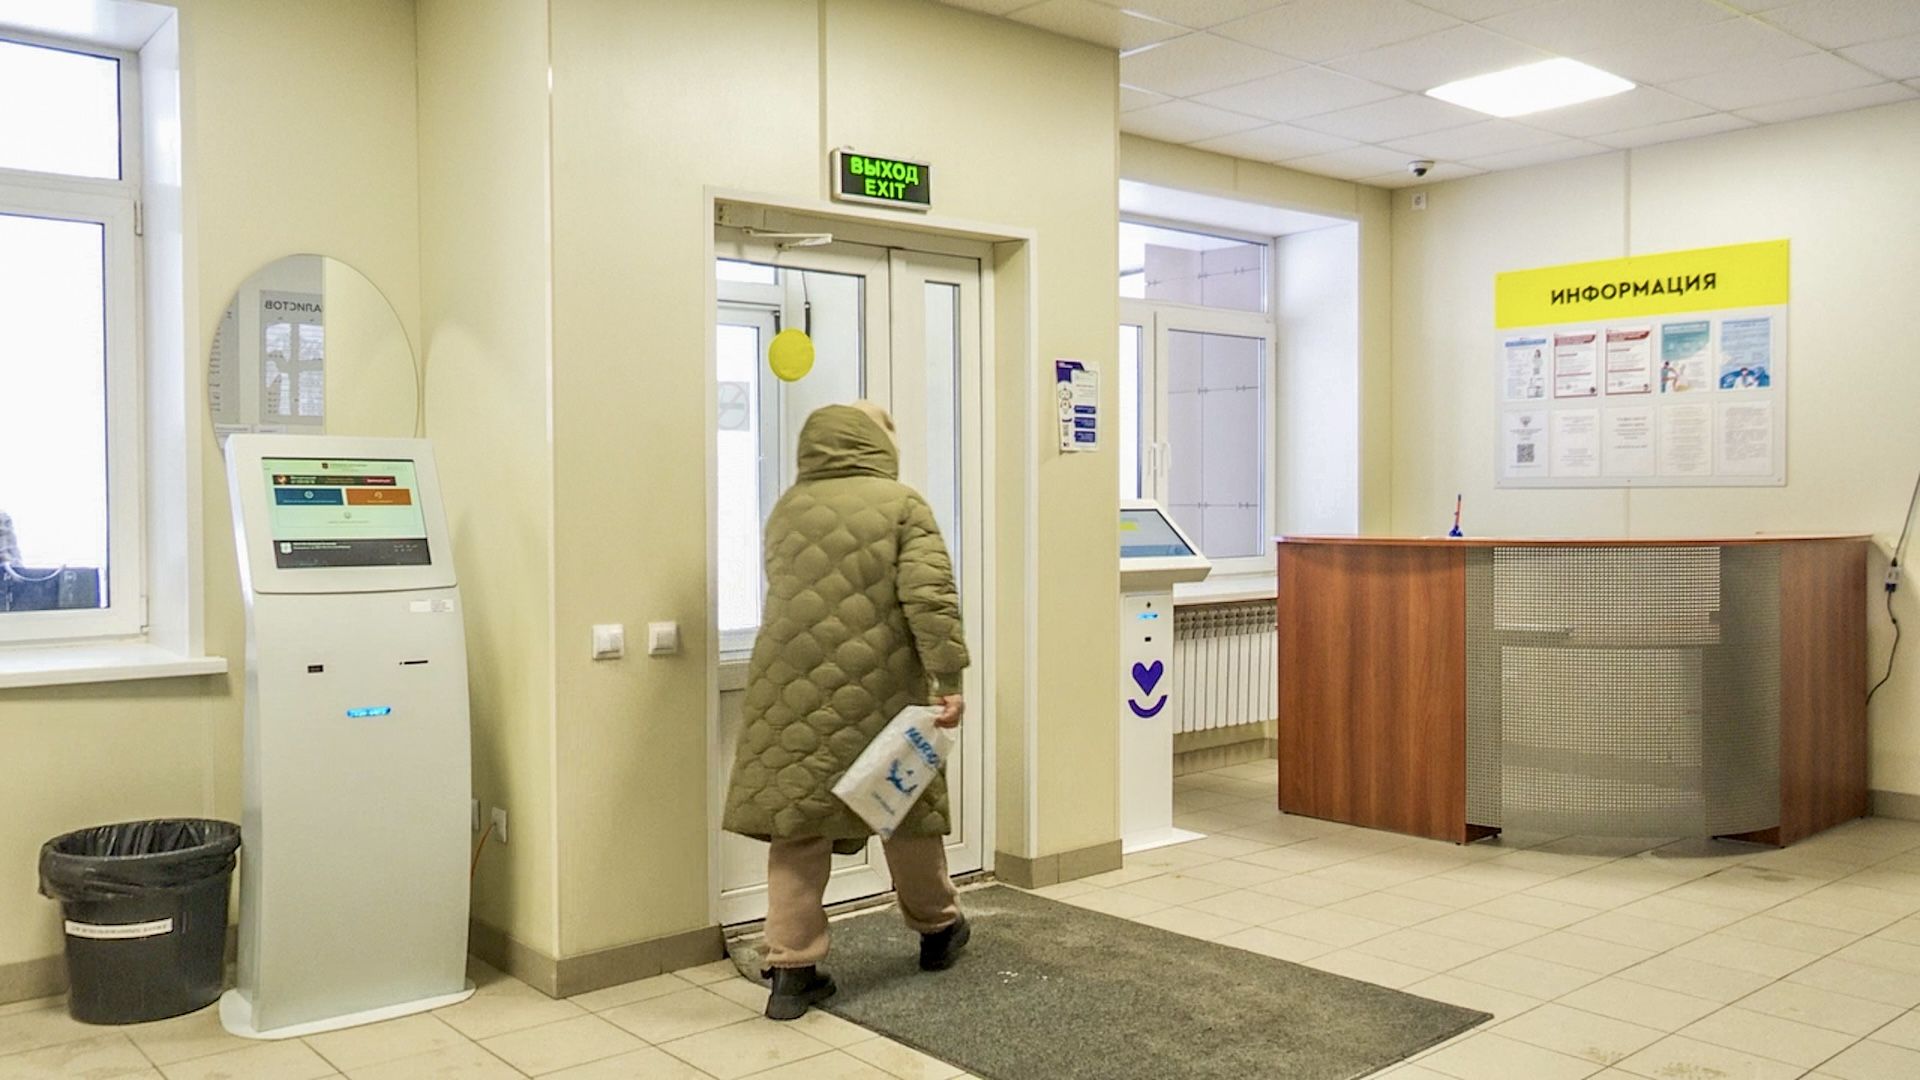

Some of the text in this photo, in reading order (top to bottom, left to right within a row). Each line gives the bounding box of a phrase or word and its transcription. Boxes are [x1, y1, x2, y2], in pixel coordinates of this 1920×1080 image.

[850, 156, 919, 185] ВЫХОД
[864, 178, 906, 199] EXIT
[1551, 272, 1716, 305] ИНФОРМАЦИЯ
